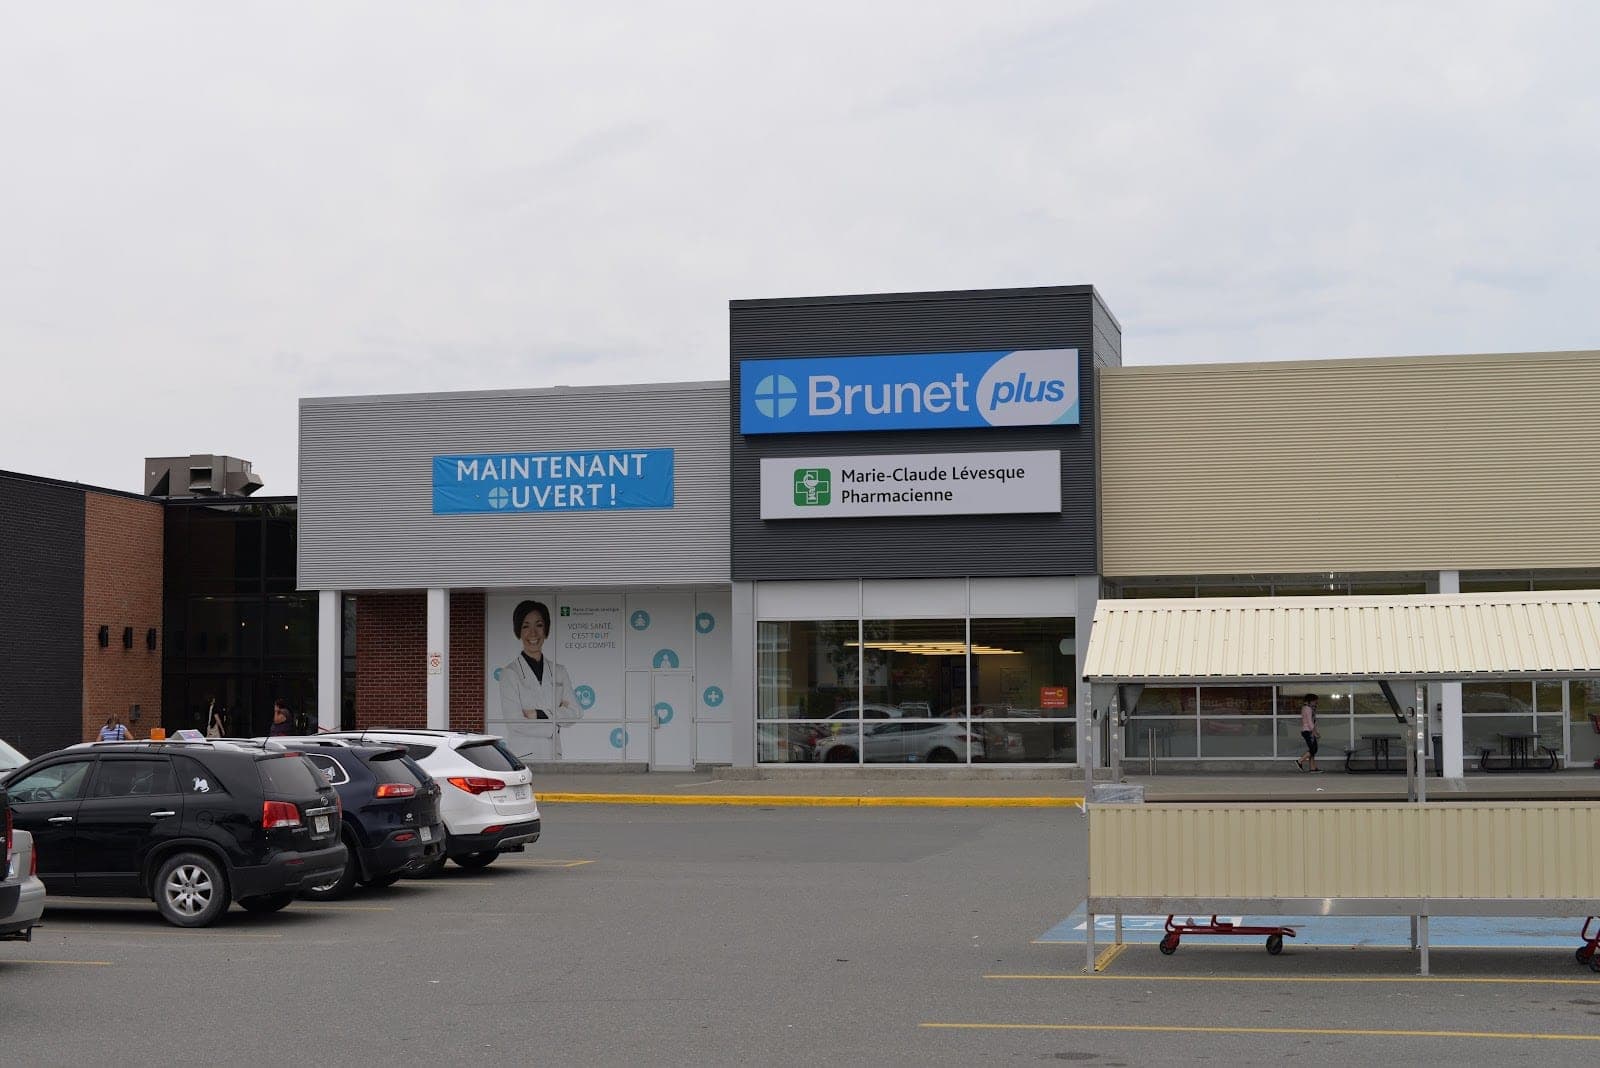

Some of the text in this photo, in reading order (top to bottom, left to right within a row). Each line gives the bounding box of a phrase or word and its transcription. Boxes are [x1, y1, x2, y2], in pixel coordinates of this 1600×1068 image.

[808, 372, 1065, 416] Brunet plus
[457, 453, 648, 481] MAINTENANT
[841, 466, 1025, 483] Marie-Claude Lévesque
[841, 488, 953, 504] Pharmacienne
[588, 641, 616, 649] COMPTE
